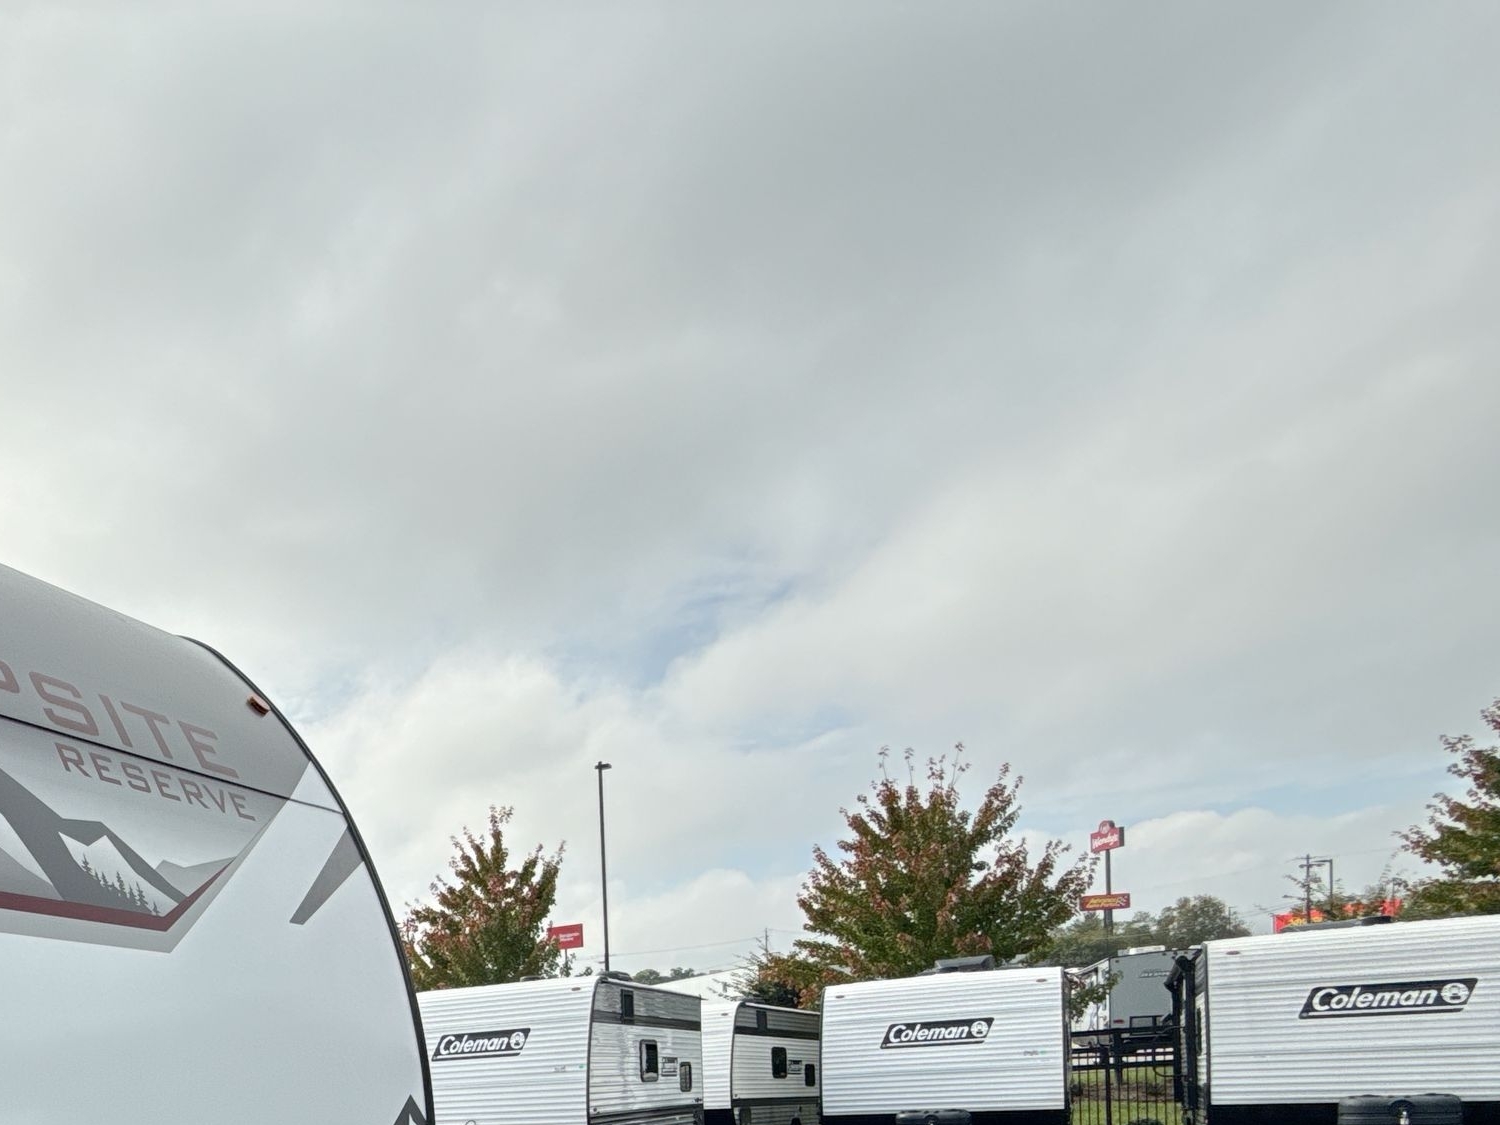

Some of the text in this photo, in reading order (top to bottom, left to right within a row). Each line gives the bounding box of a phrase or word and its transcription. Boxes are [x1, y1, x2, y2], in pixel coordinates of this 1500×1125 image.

[54, 742, 257, 822] RESERVE
[1311, 986, 1438, 1012] Coleman
[439, 1034, 510, 1056] Coleman
[888, 1023, 970, 1044] Coleman
